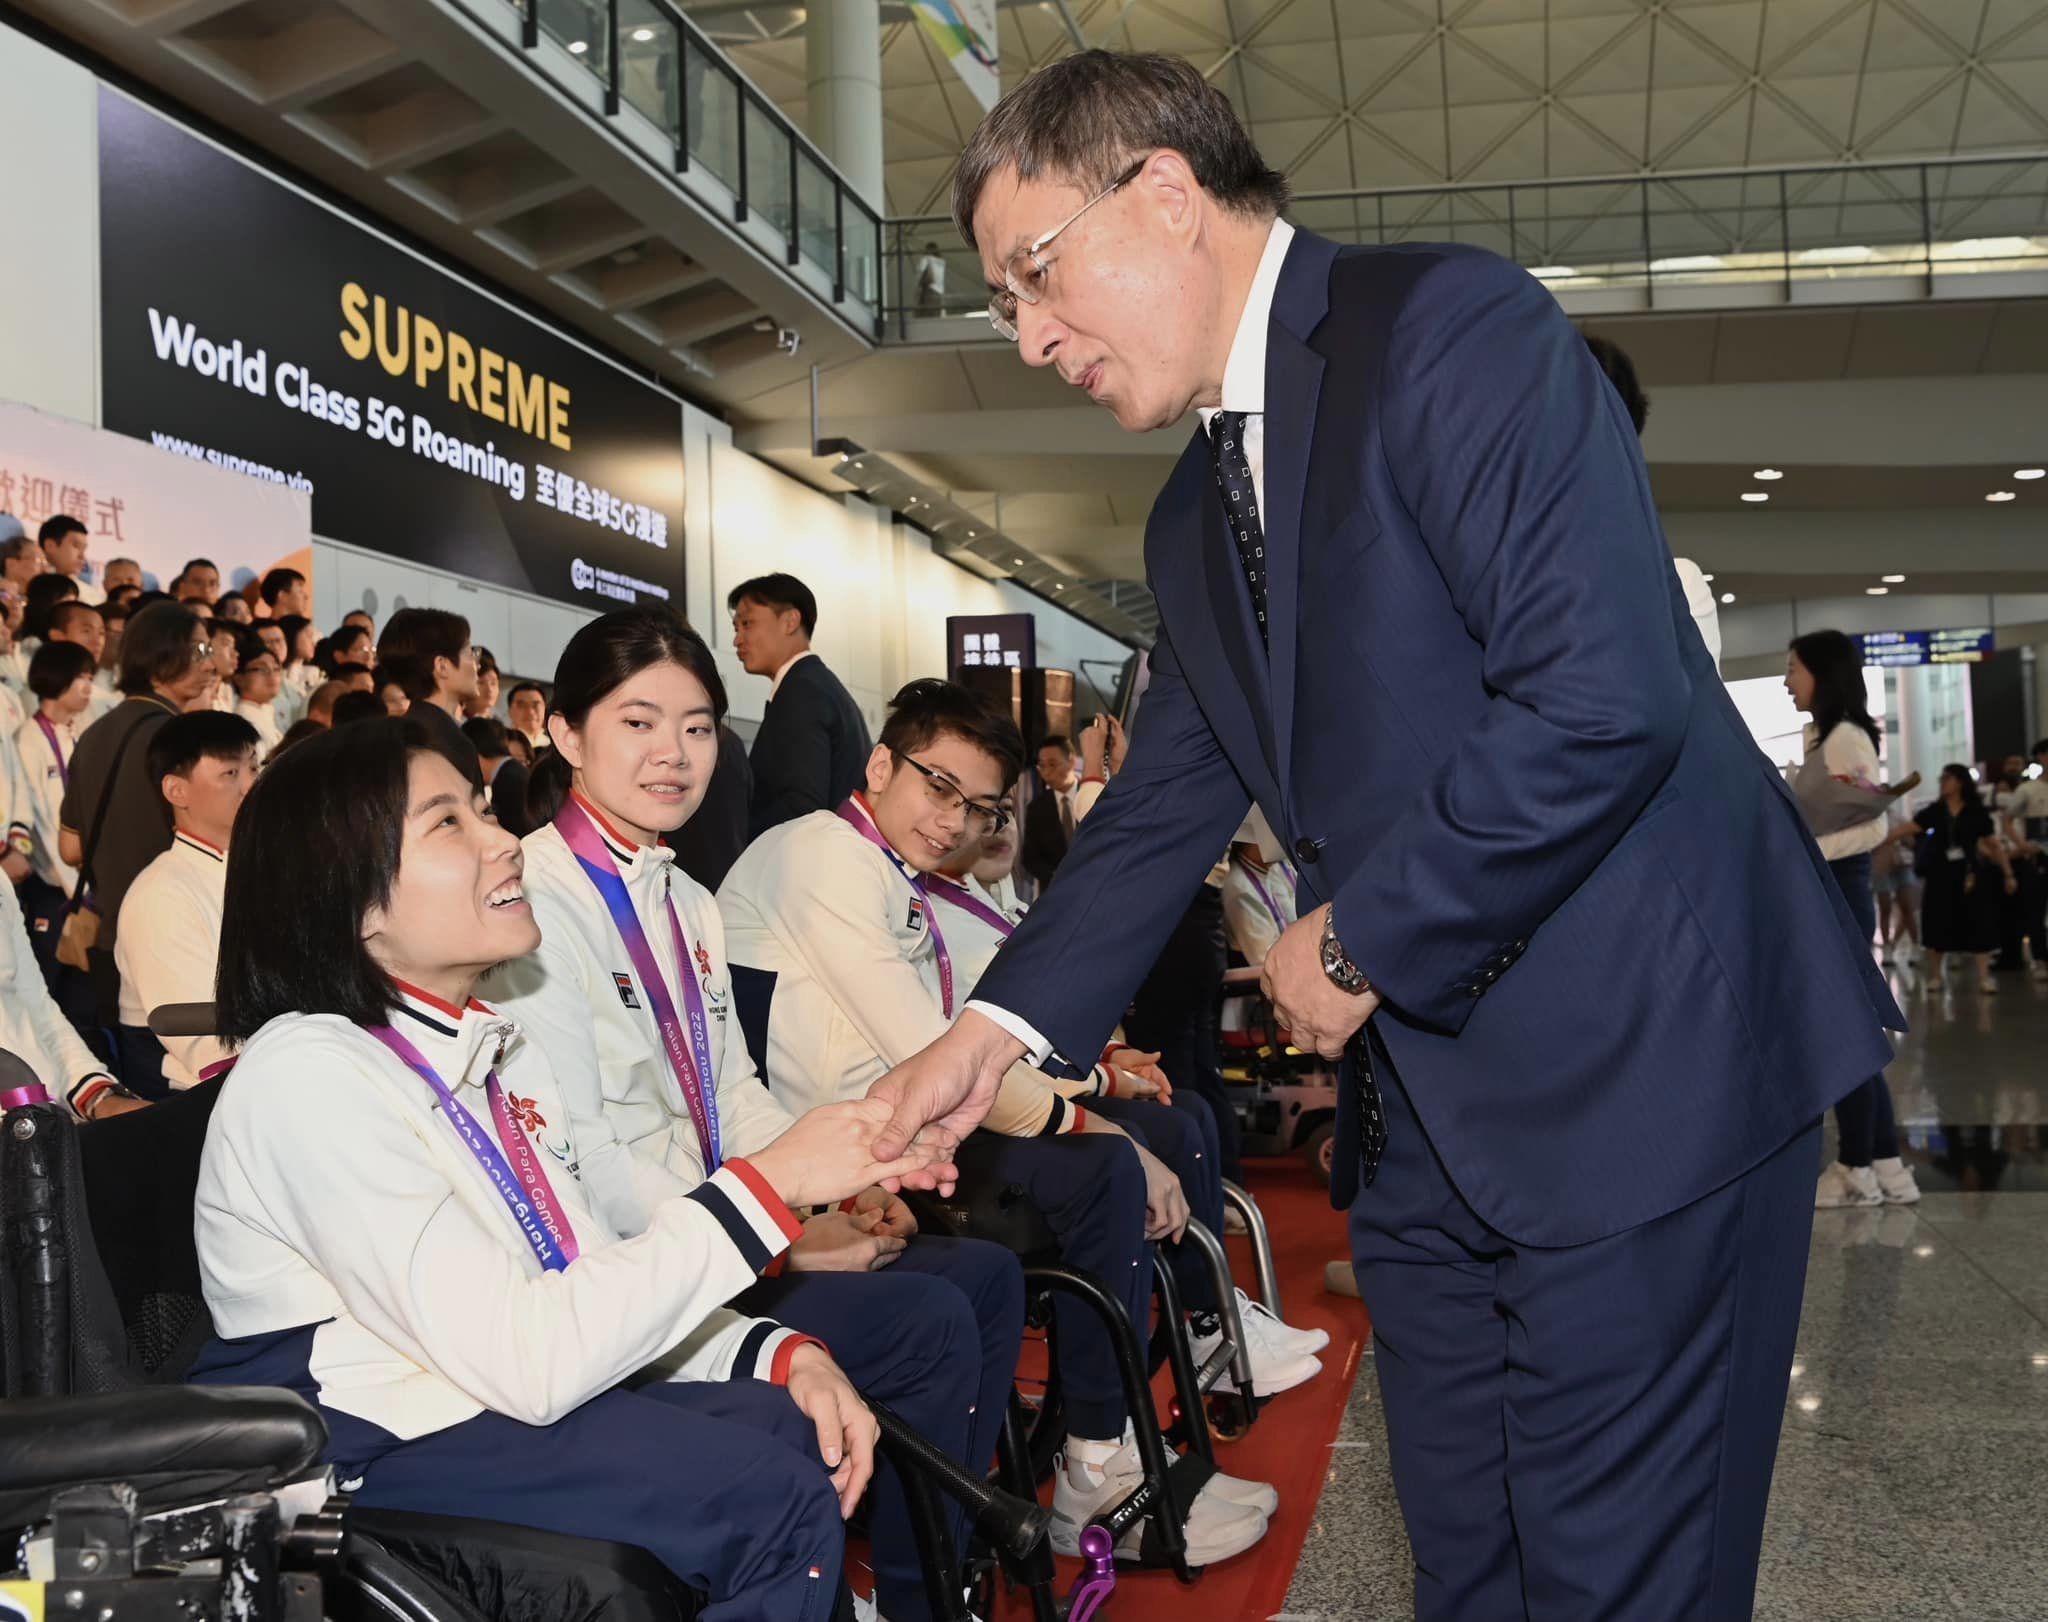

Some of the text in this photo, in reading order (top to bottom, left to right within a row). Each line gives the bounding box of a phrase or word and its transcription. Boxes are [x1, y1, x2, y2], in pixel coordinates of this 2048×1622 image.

[148, 307, 267, 397] World
[275, 362, 361, 431] Class
[366, 397, 406, 447] 5G
[412, 414, 526, 501] Roaming
[340, 282, 572, 451] SUPREME
[151, 430, 314, 495] wwwsupremevip
[663, 1021, 709, 1144] Asian Para Gam
[691, 1011, 719, 1141] Hangzhou 2022
[516, 1146, 537, 1185] Para
[530, 1187, 563, 1244] Games
